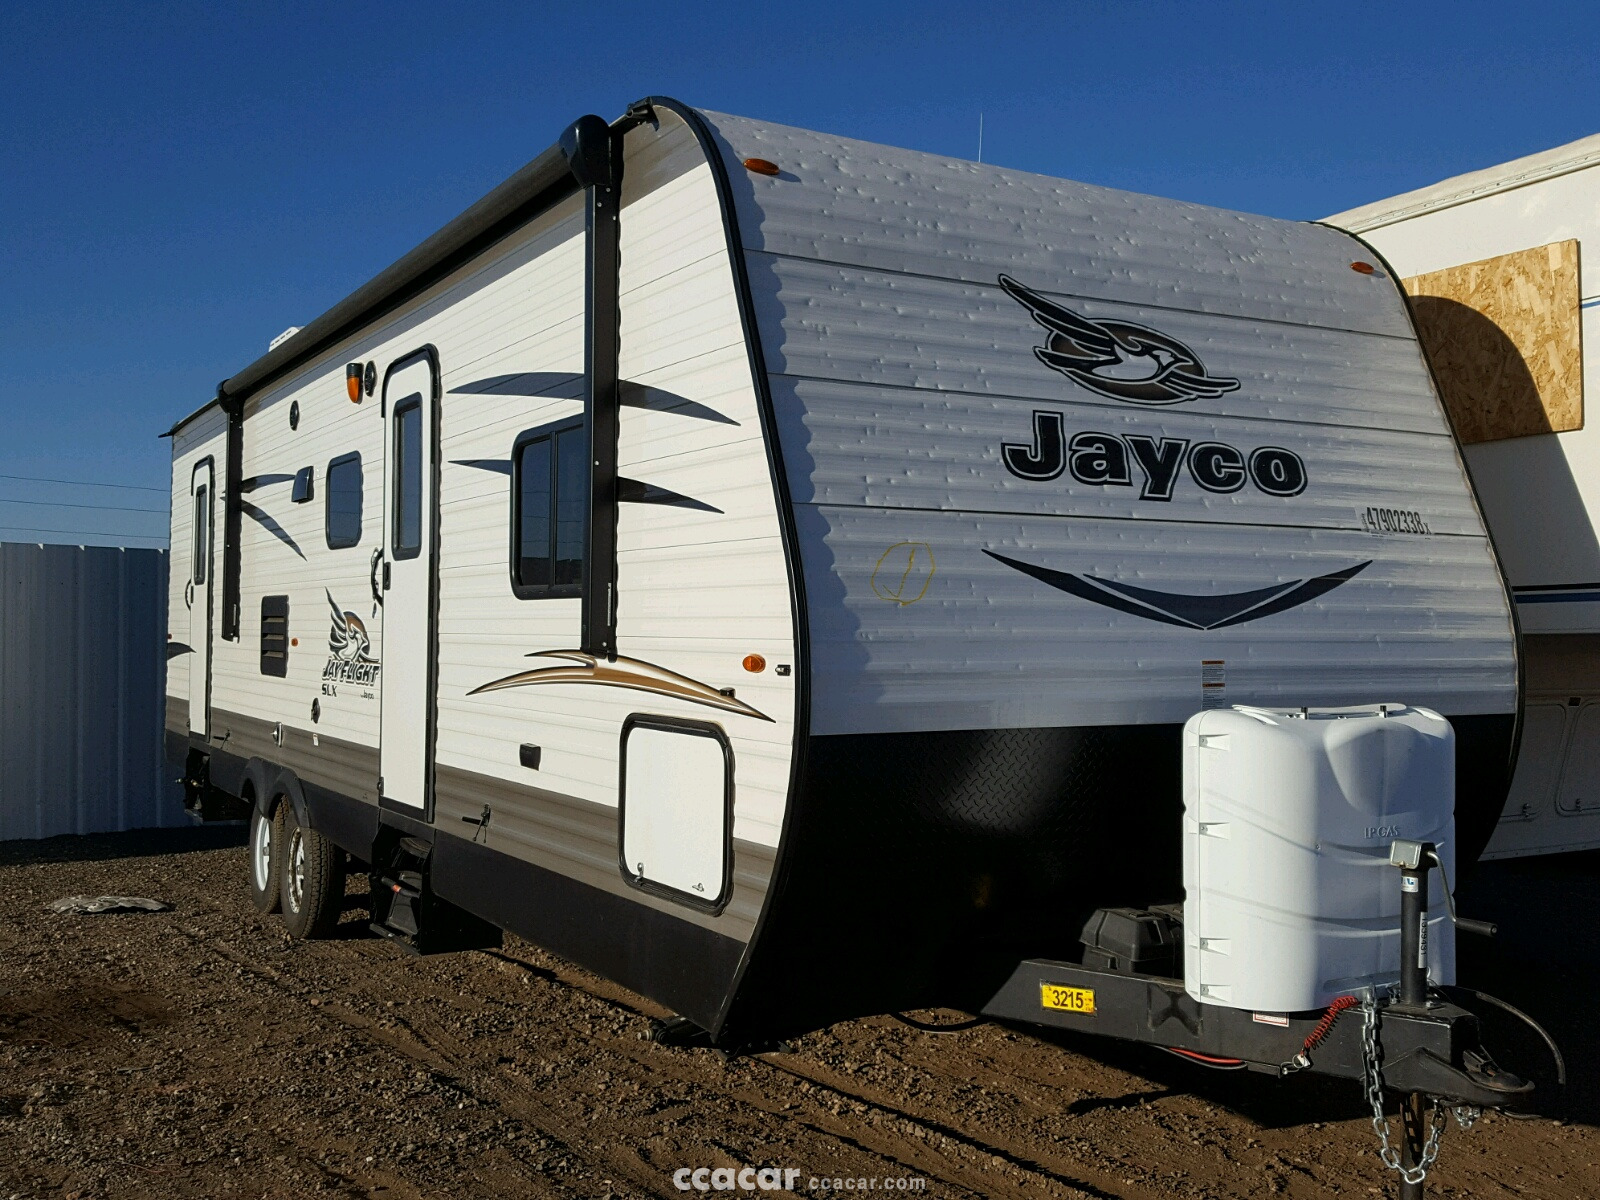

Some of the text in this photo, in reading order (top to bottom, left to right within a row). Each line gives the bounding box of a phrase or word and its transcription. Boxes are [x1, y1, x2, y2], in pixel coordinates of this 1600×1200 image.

[1001, 410, 1308, 501] Jayco
[1366, 507, 1425, 534] 47902338
[322, 658, 380, 687] JAY FLIGHT
[322, 683, 337, 697] SLX
[1376, 825, 1399, 837] GAS
[1052, 990, 1084, 1008] 3215
